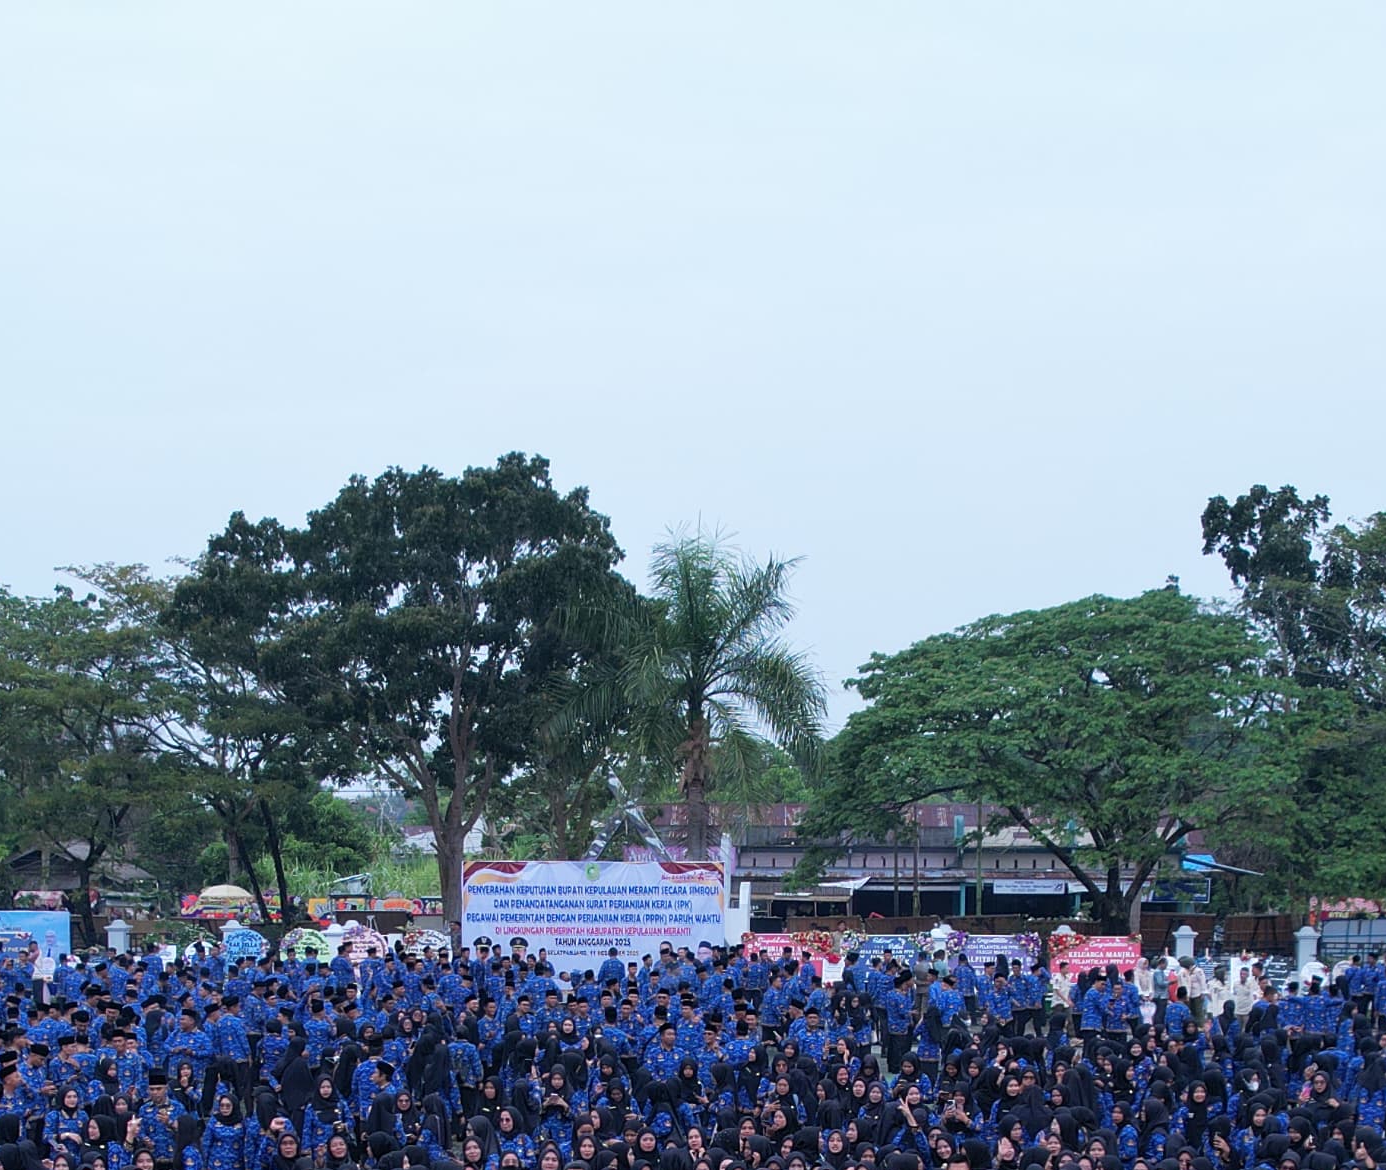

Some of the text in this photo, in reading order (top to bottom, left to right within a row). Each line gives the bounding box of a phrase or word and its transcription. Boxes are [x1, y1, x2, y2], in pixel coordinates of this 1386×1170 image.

[468, 885, 719, 897] PENYERAHAN KEPUTUSAN BUPATI KEPULAUAN MERANTI SECARA SIMBOLIS
[494, 899, 693, 911] DAN PENANDATANGANAN SURAT PERJANJIAN KERJA (SPK)
[466, 913, 721, 925] PEGAWAI PEMERINTAH DENGAN PERJANJIAN KERJA (PPPK) PARUH WAKTU
[495, 927, 691, 936] DI LINGKUNGAN PEMERINTAH KABUPATEN KEPULAUAN MERANTI
[555, 938, 631, 947] TAHUN ANGGARAN 2025
